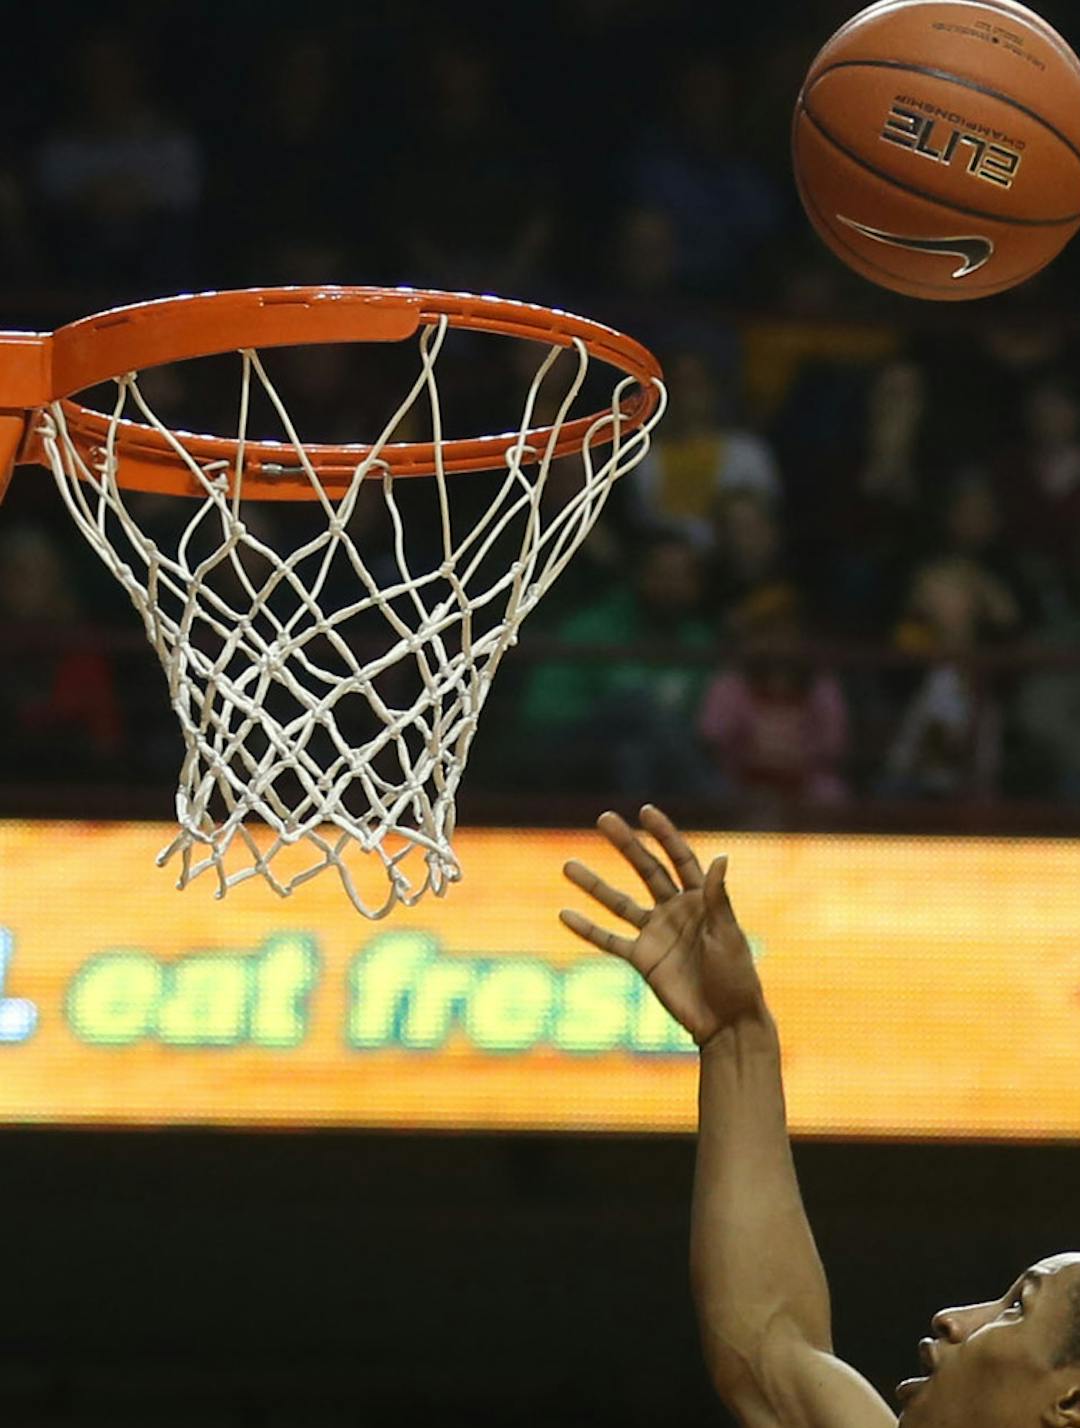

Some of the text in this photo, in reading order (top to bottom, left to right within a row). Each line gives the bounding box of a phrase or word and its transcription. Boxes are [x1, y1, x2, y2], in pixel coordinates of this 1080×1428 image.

[879, 104, 1022, 190] ELITE
[894, 95, 1027, 150] CHAMPIONSHIP
[66, 930, 322, 1047] eat
[345, 930, 701, 1054] fres
